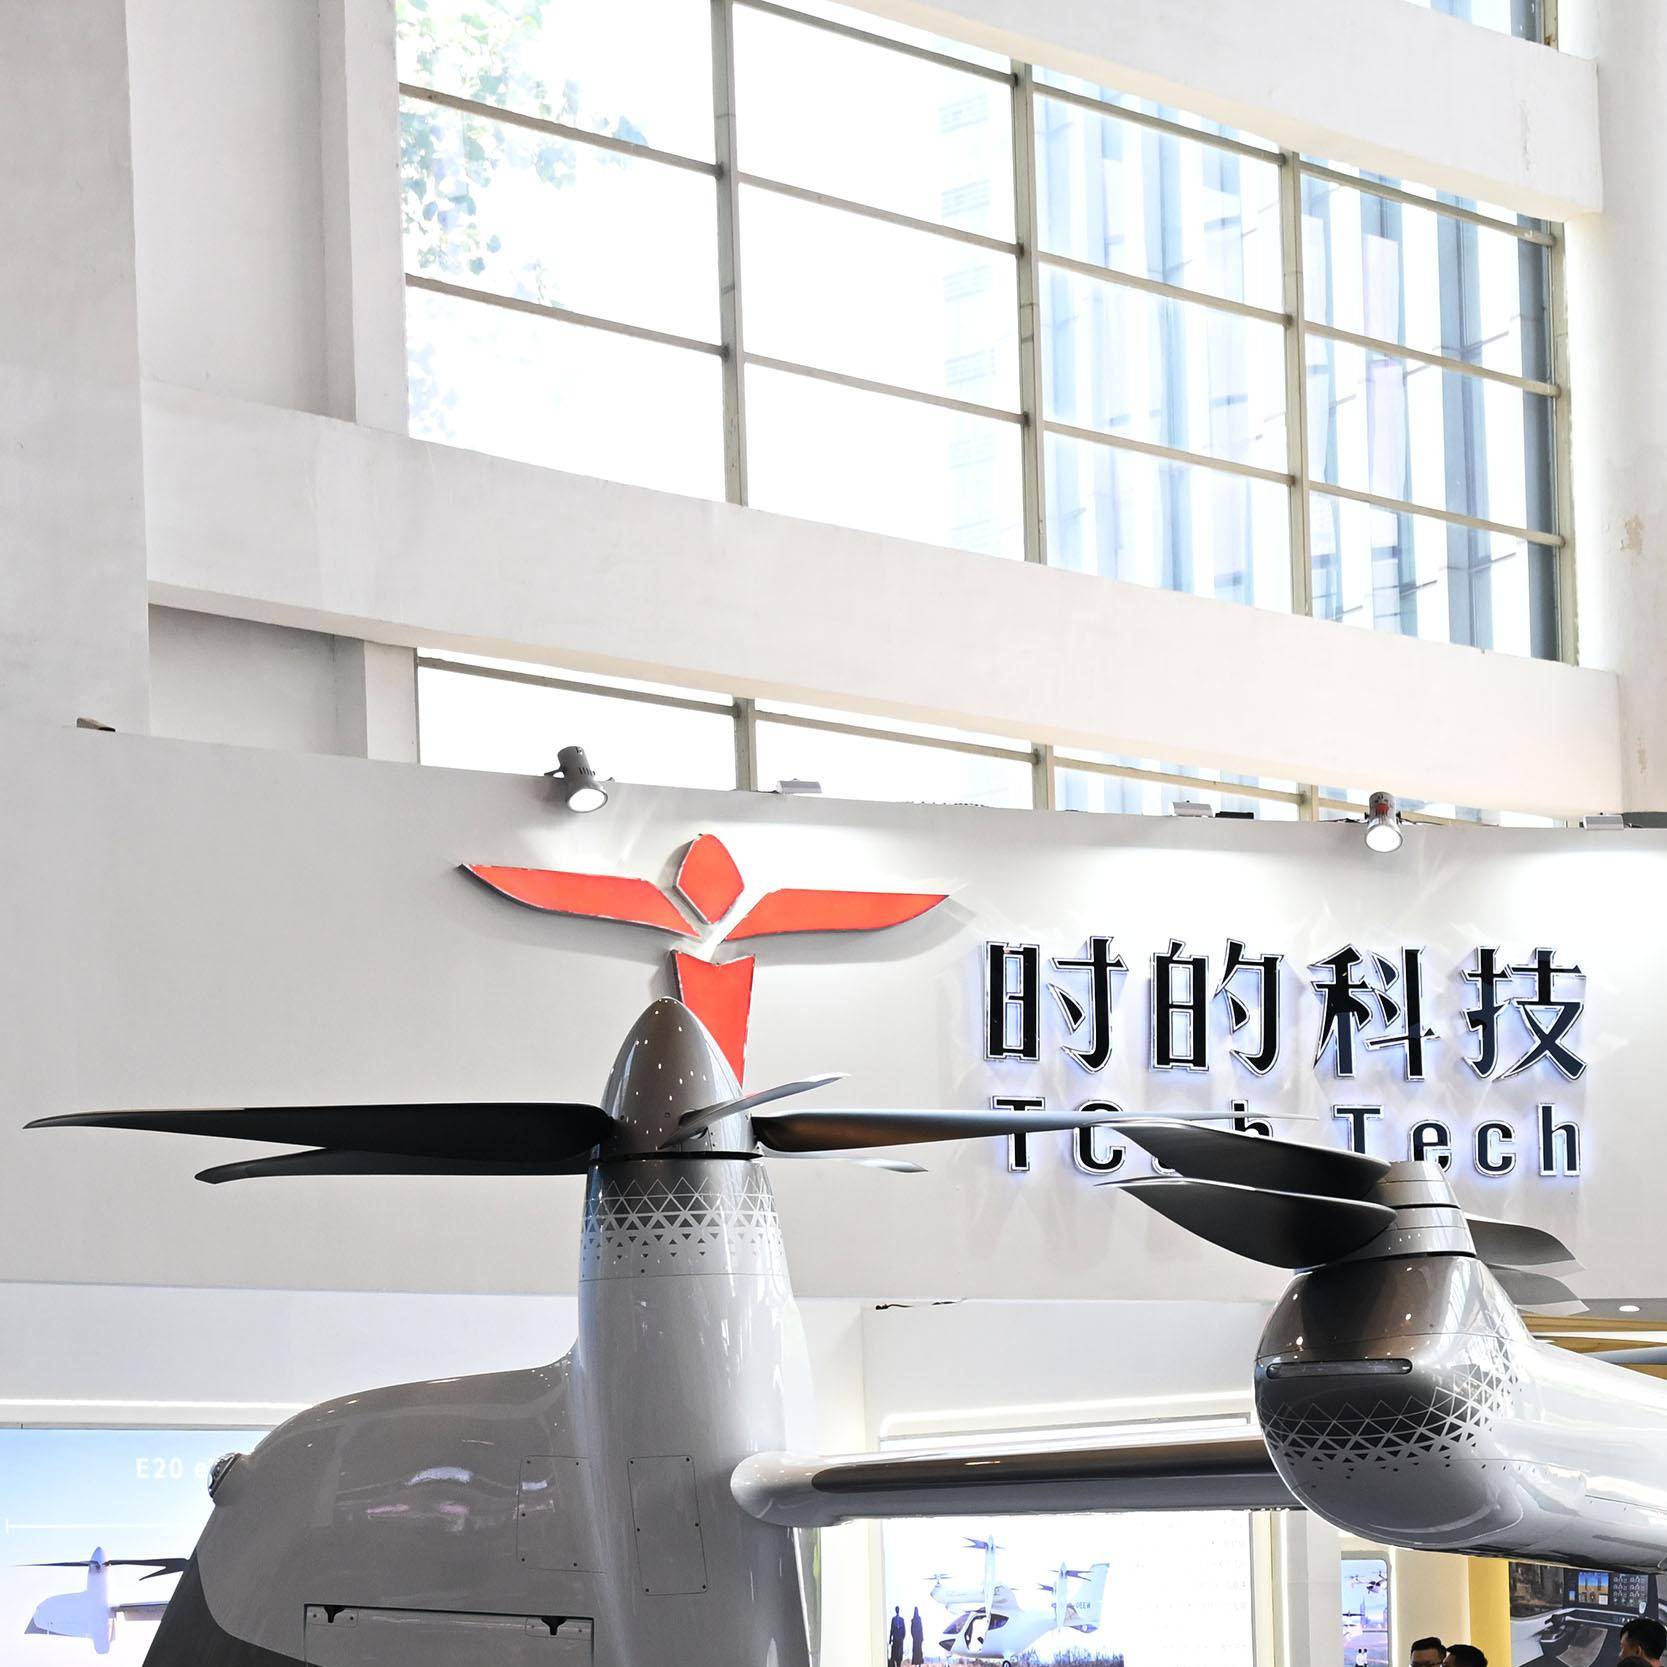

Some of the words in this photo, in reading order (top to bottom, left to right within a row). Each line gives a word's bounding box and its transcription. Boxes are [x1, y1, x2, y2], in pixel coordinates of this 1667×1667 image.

[983, 936, 1587, 1082] 时的科技
[990, 1095, 1274, 1175] TC
[1332, 1103, 1582, 1177] Tech
[136, 1458, 184, 1479] E20
